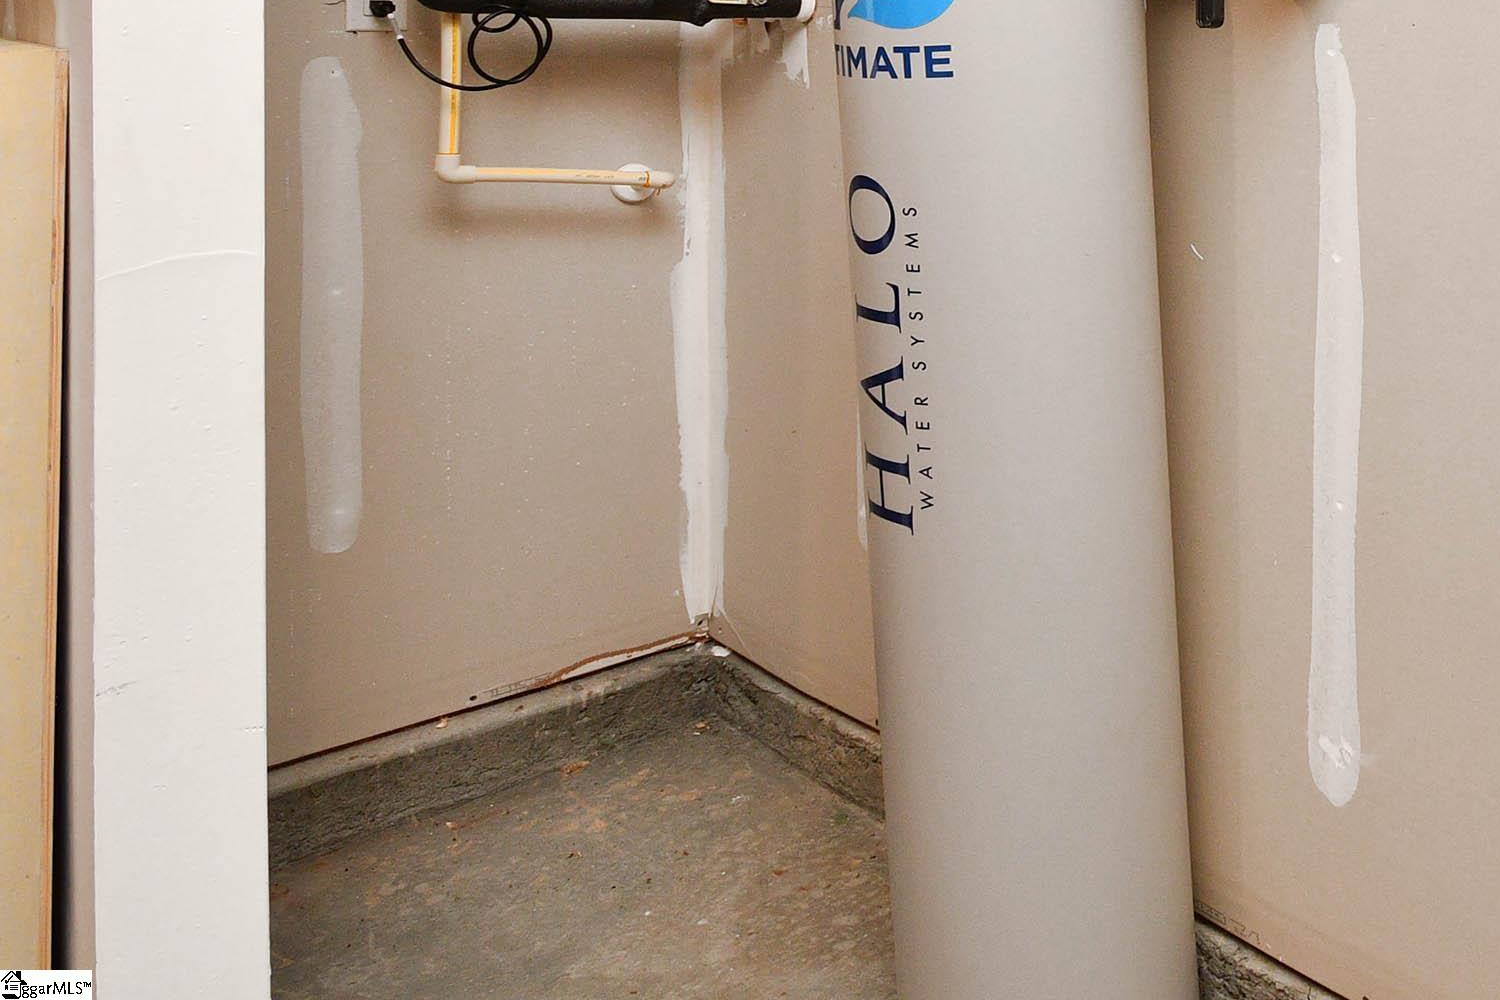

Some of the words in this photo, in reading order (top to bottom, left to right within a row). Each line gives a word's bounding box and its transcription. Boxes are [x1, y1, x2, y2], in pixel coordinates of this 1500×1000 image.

[848, 174, 915, 537] HALO
[902, 206, 927, 371] SYSTEMS
[913, 395, 935, 511] WATER
